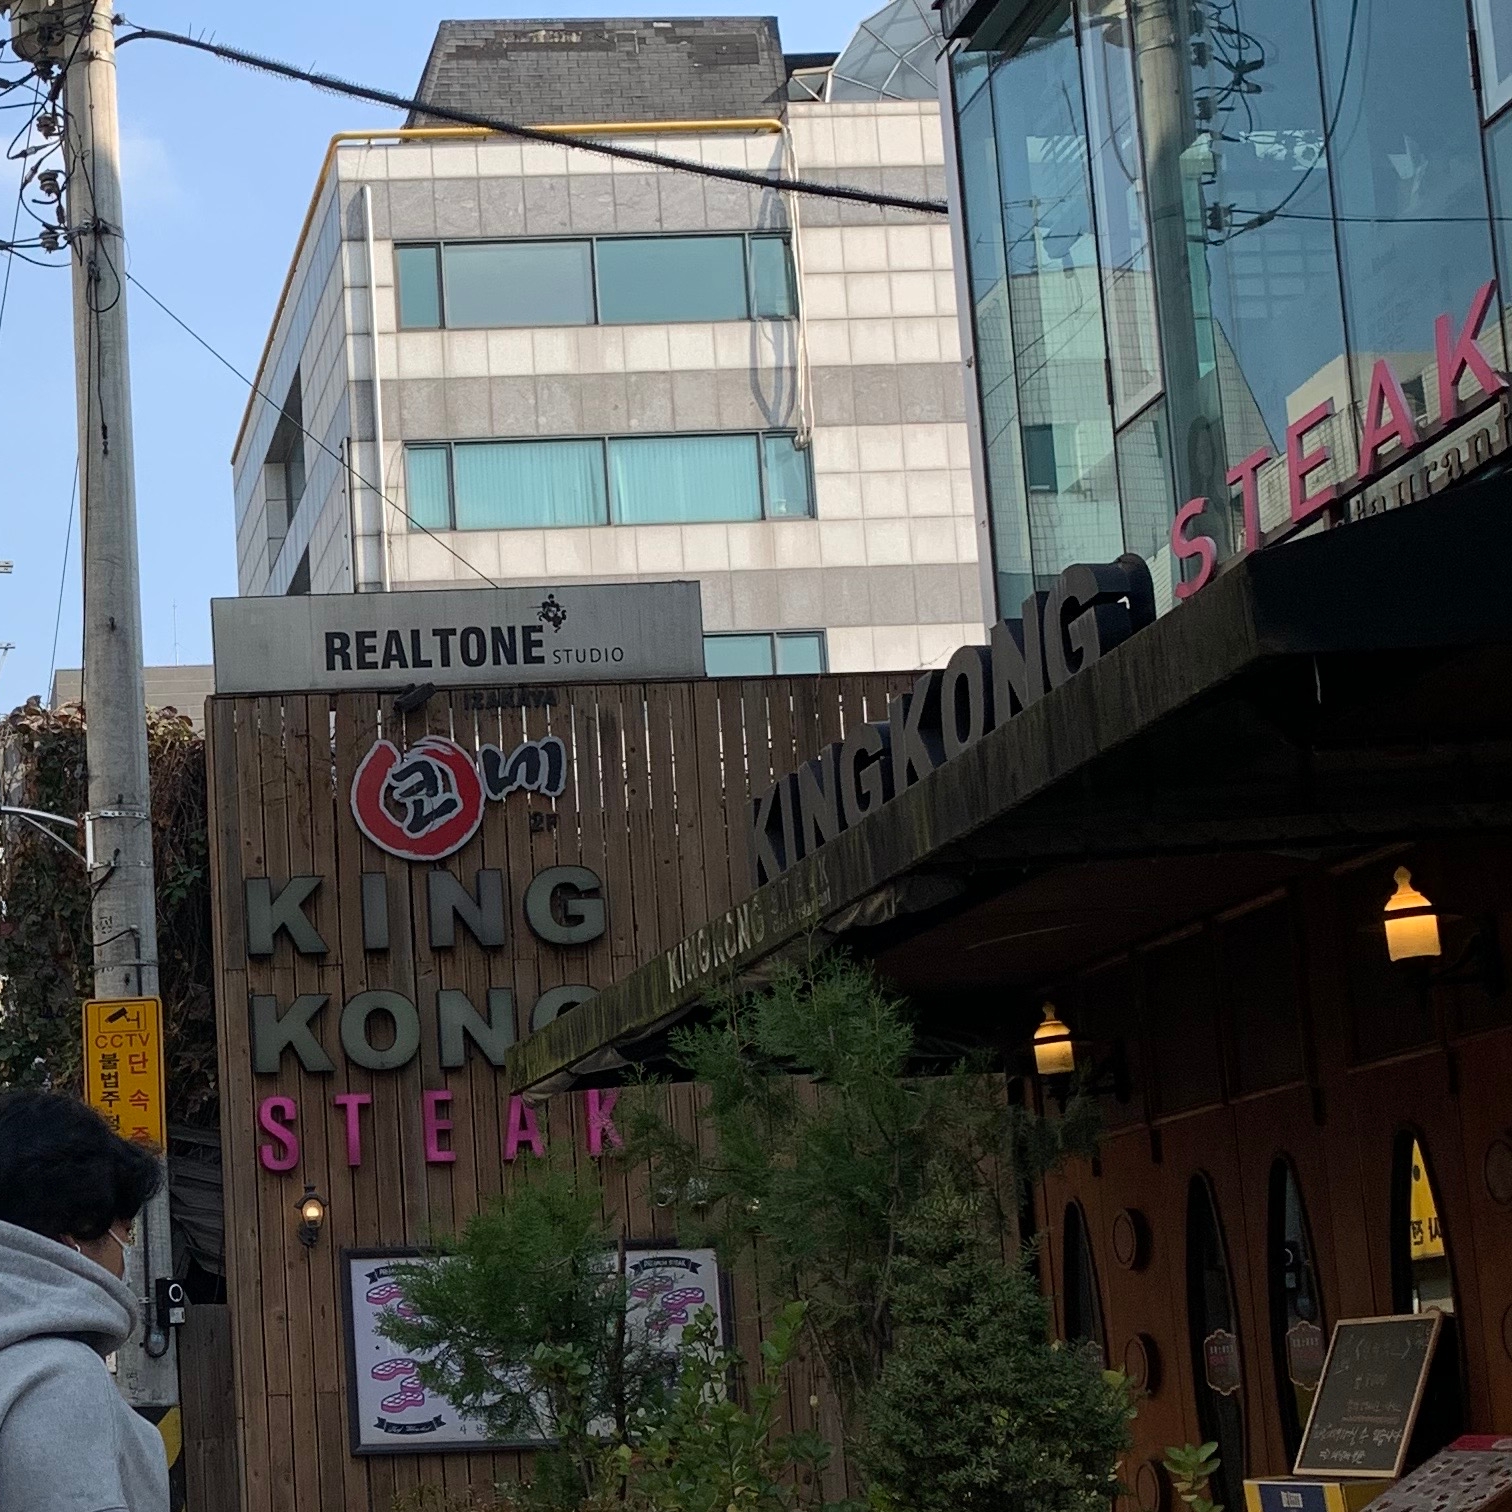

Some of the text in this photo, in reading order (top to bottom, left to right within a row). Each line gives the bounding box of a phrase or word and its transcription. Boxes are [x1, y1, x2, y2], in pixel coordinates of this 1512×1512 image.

[1171, 279, 1509, 599] STEAK
[324, 625, 625, 671] REALTONE STUDIO
[246, 864, 608, 957] KING
[95, 1033, 150, 1049] CCTV
[258, 1087, 626, 1172] STEAK
